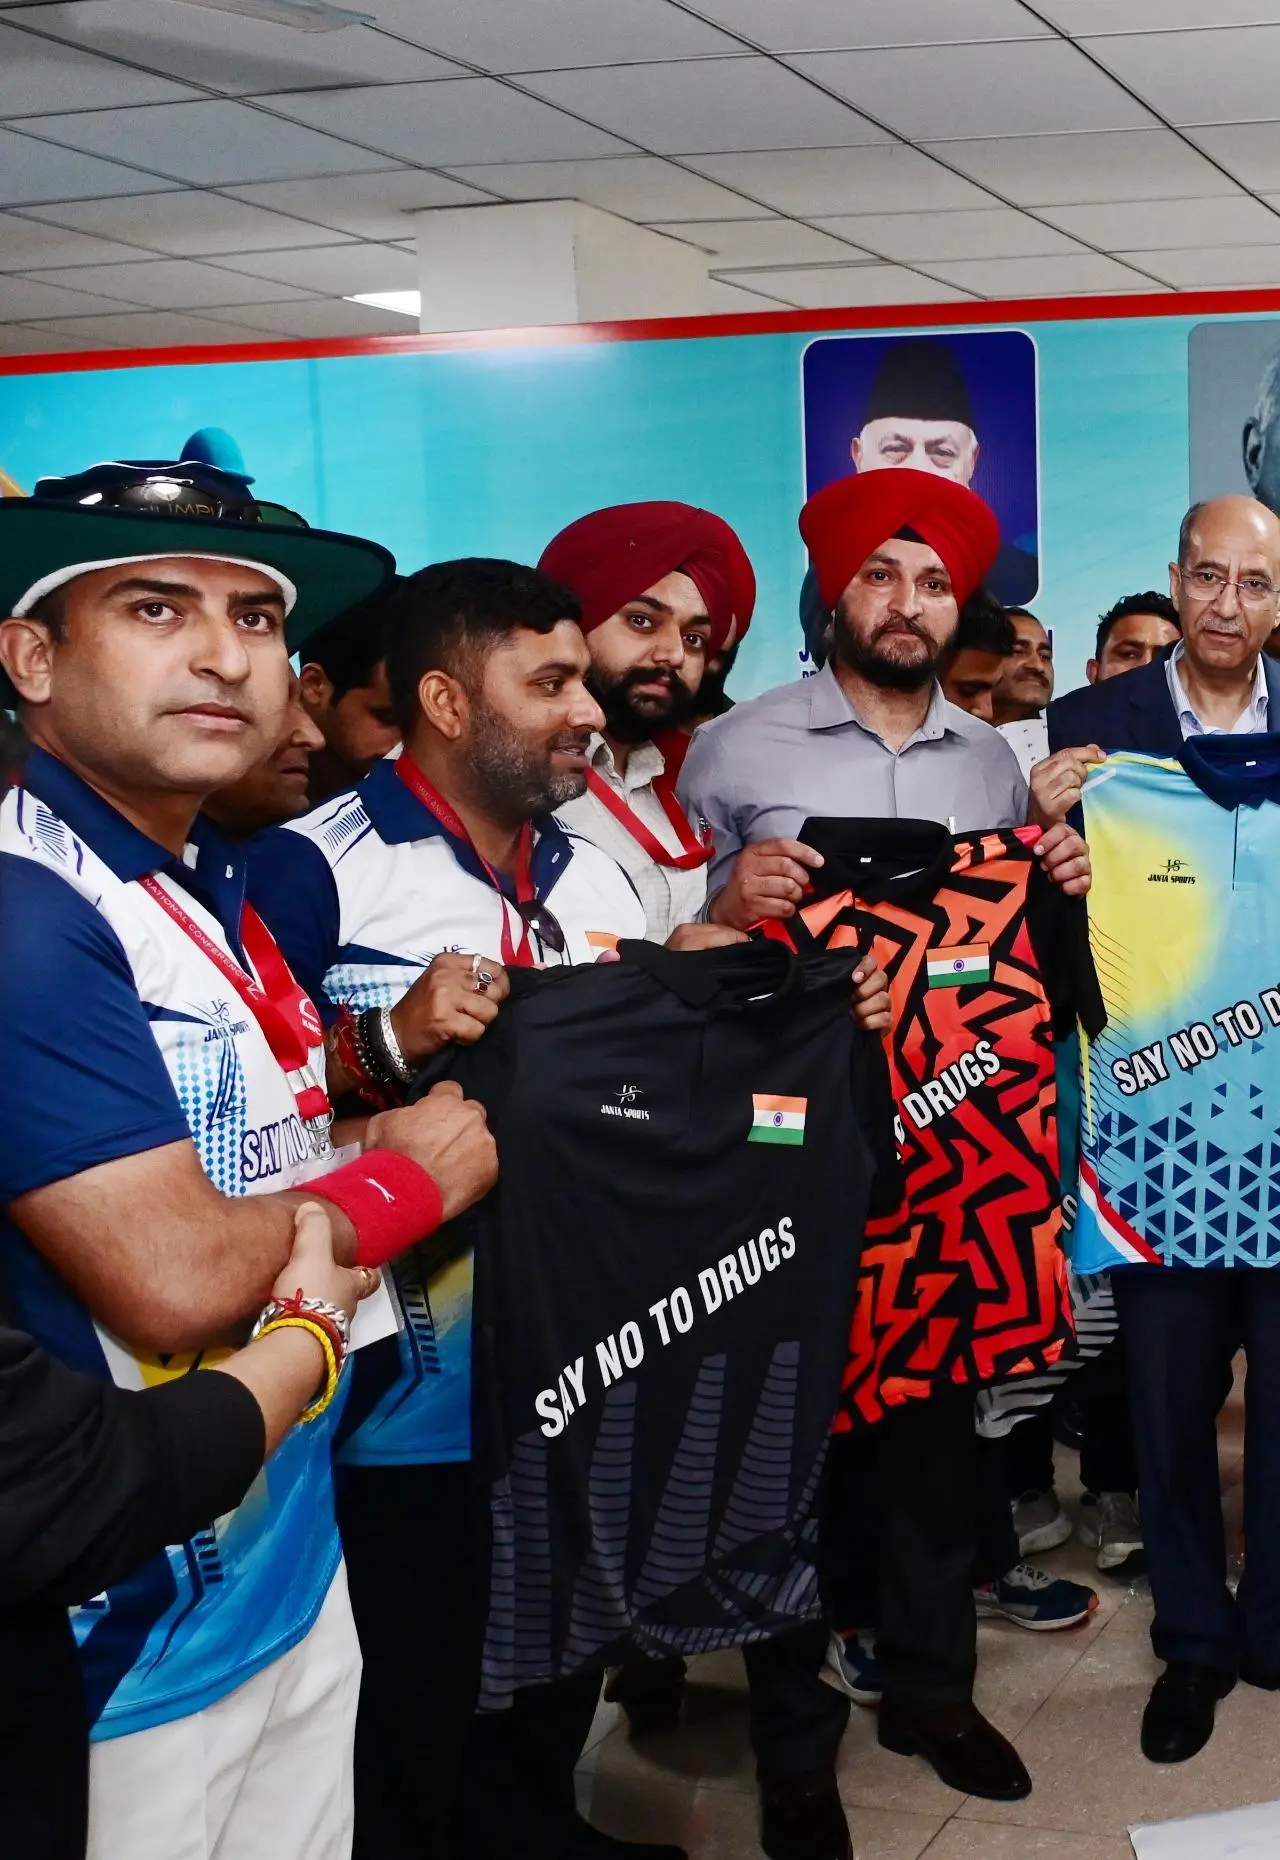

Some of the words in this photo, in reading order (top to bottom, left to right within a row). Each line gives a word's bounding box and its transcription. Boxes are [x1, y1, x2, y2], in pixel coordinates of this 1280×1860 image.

[1147, 873, 1169, 882] JANTA
[1170, 876, 1196, 885] SPORTS
[144, 878, 188, 924] NATIONAL
[188, 923, 250, 983] CONFERENCE
[901, 1040, 1001, 1129] DRUGS
[1111, 1040, 1170, 1096] SAY
[1167, 1021, 1218, 1071] NO
[1213, 1000, 1263, 1046] TO
[240, 1129, 282, 1182] SAY
[600, 1104, 622, 1117] JANTA
[623, 1107, 650, 1120] SPORTS
[535, 1355, 587, 1438] SAY
[595, 1320, 645, 1388] NO
[648, 1286, 694, 1346] TO
[697, 1216, 797, 1315] DRUGS
